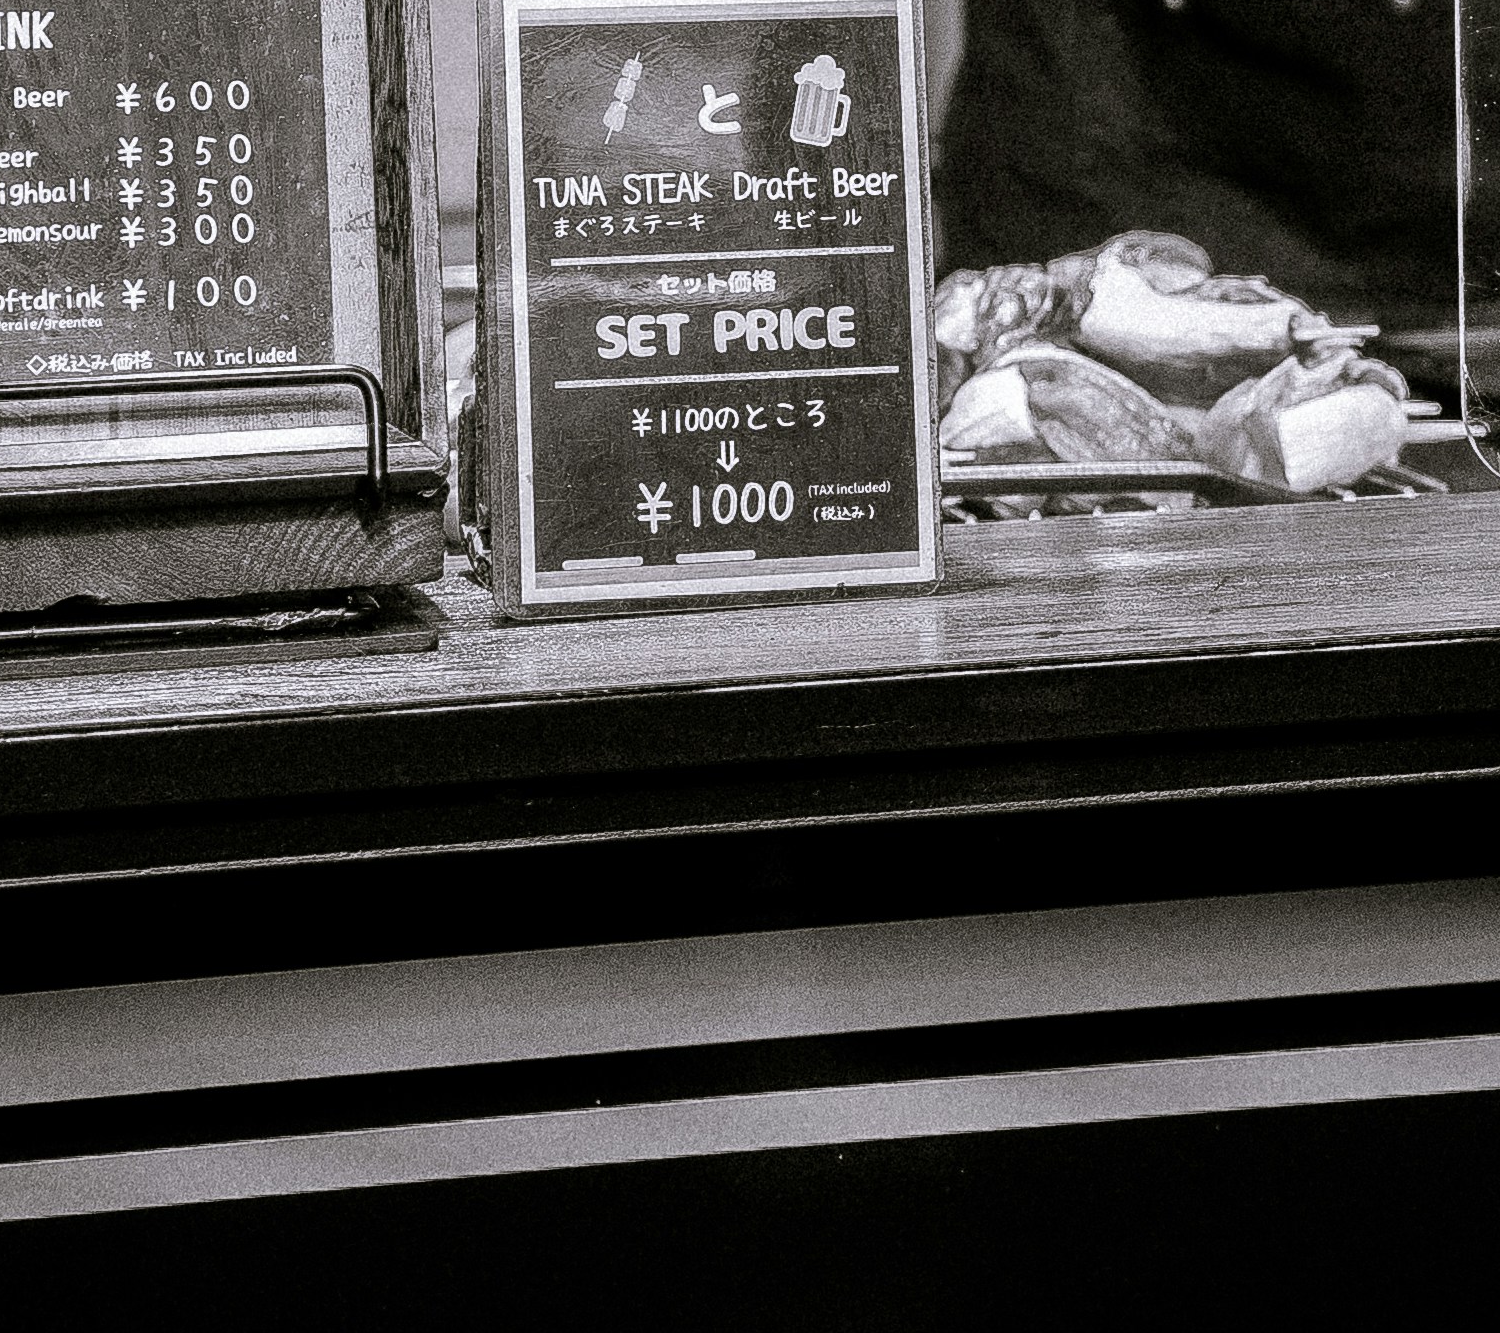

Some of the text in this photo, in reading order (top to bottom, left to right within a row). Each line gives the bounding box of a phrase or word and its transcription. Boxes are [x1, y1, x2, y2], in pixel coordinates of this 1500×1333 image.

[13, 86, 71, 110] Beer
[698, 83, 743, 136] と
[533, 167, 900, 209] TUNA STEAK Draft Beer
[553, 212, 707, 239] まぐろステーキ
[774, 207, 863, 233] 生ビール
[656, 268, 777, 296] セット価格
[596, 305, 856, 359] SET PRICE
[174, 346, 298, 368] TAX Included
[631, 399, 827, 437] ¥1100のところ
[808, 480, 891, 499] (TAX included)
[636, 479, 795, 534] ¥1000
